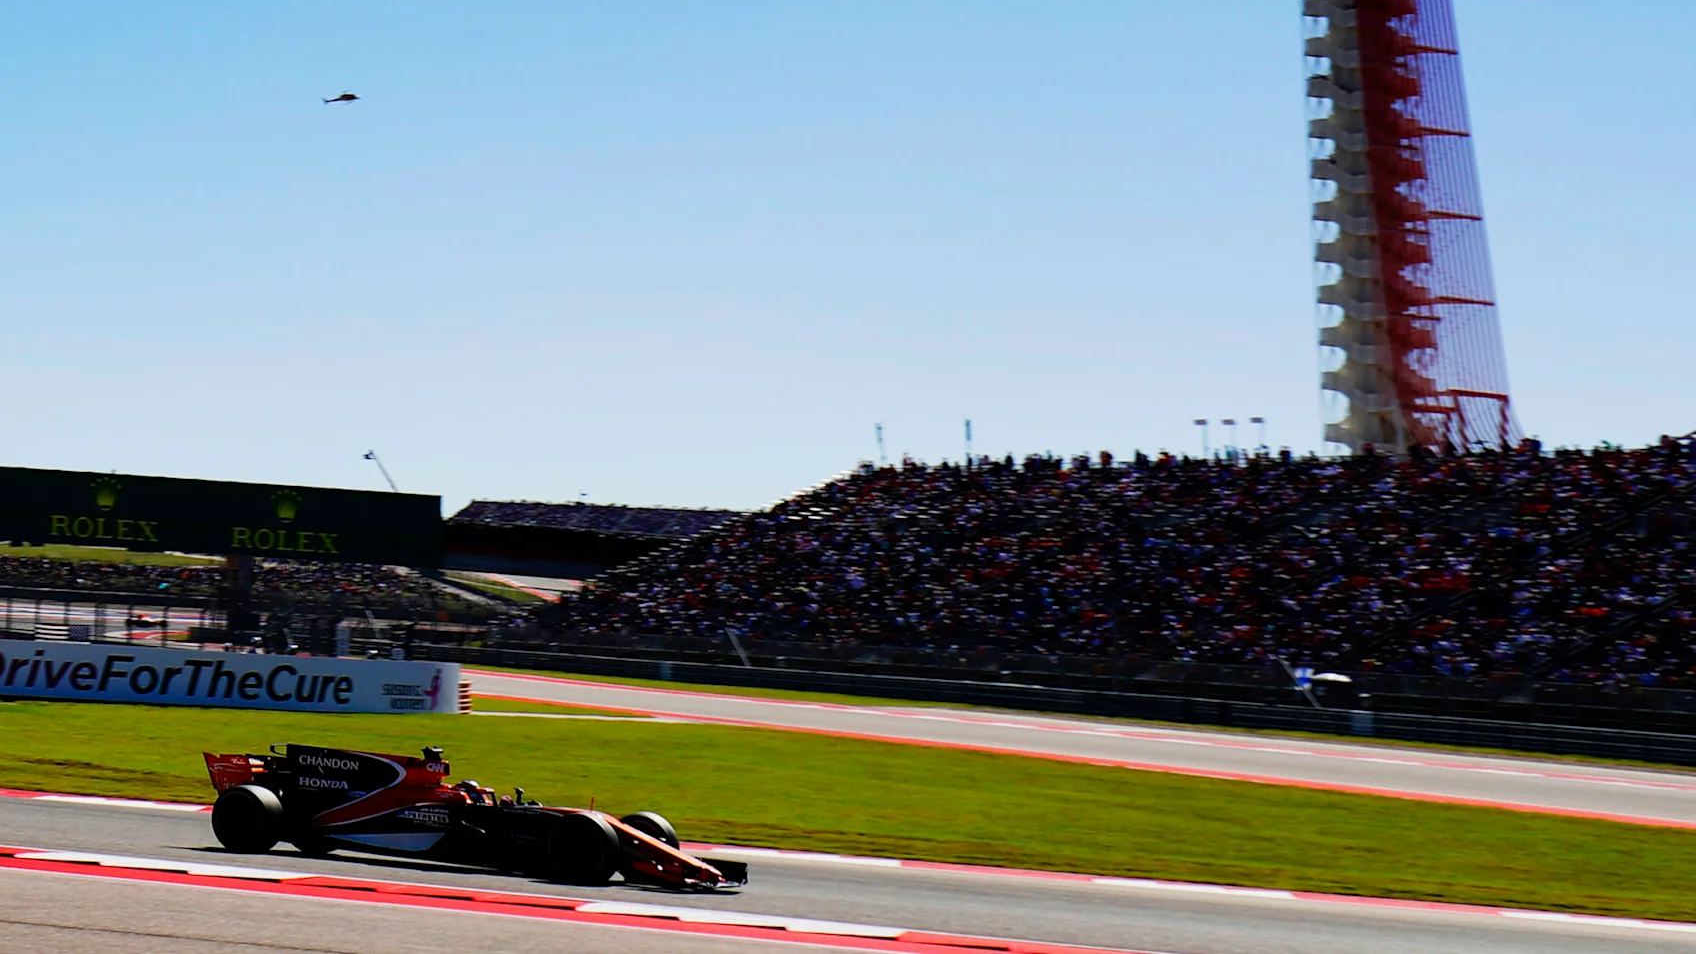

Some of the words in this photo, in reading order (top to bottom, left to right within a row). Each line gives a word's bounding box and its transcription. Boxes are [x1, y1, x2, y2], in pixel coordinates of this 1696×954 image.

[49, 514, 160, 542] ROLEX
[230, 526, 341, 554] ROLEX
[298, 754, 359, 771] CHANDON
[298, 776, 349, 790] HONDA
